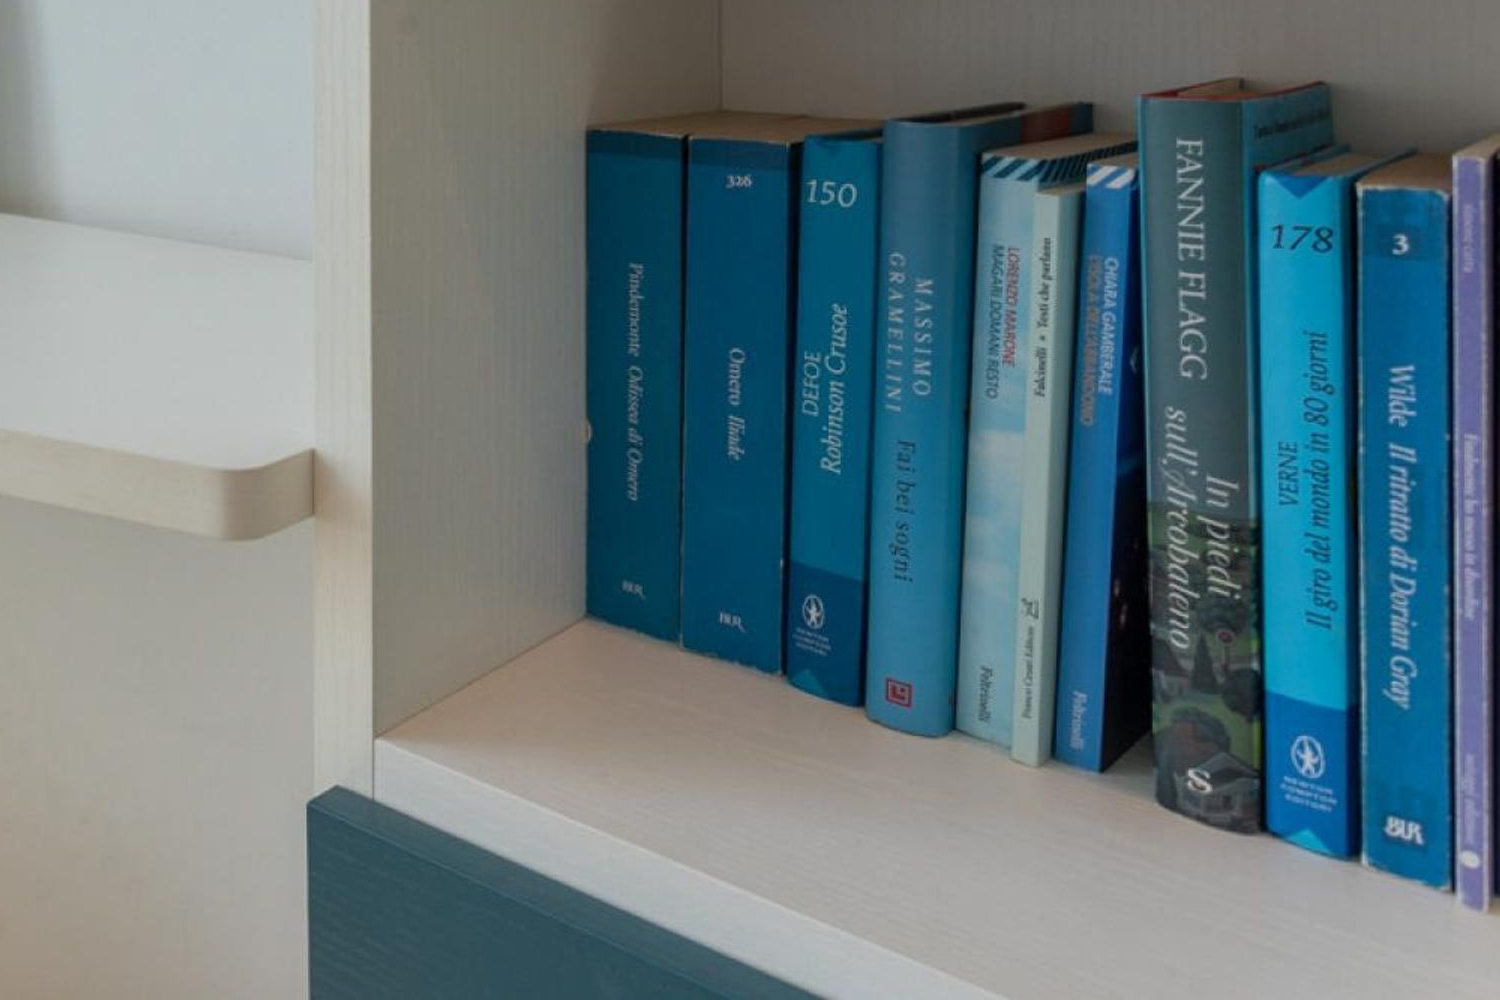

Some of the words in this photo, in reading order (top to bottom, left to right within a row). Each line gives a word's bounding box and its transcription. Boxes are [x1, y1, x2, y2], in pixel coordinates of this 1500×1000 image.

[725, 173, 753, 189] 326
[804, 178, 859, 209] 150
[1175, 136, 1205, 262] FANNIE
[1038, 237, 1052, 281] parlano
[1270, 223, 1335, 253] 178
[1392, 233, 1410, 256] 3
[990, 243, 1006, 298] MAGARI
[1005, 247, 1021, 307] LORENZO
[1038, 282, 1050, 302] che
[1103, 256, 1120, 309] CHIARA
[627, 262, 645, 357] Pindemonte
[885, 251, 907, 413] GRAMELLINI
[988, 299, 1003, 356] DOMANI
[1036, 303, 1050, 329] Testi
[1178, 269, 1208, 381] FLAGG
[824, 303, 848, 376] Crusoe
[912, 278, 934, 397] MASSIMO
[1001, 309, 1018, 369] MARONE
[1098, 310, 1117, 396] GAMBERALE
[1302, 329, 1336, 396] giorni
[627, 365, 645, 424] Odissea
[728, 347, 747, 406] Omero
[801, 350, 822, 417] DEFOE
[986, 358, 1001, 400] RESTO
[1388, 364, 1417, 427] Wilde
[626, 427, 644, 446] di
[727, 415, 746, 461] Iliade
[819, 380, 846, 475] Robinson
[1303, 397, 1330, 428] 80
[896, 439, 917, 474] Fai
[1306, 433, 1330, 454] in
[1389, 441, 1417, 463] Il
[626, 447, 643, 501] Omero
[895, 479, 916, 516] bei
[1204, 474, 1240, 509] In
[1277, 441, 1299, 507] VERNE
[1304, 460, 1331, 530] mondo
[1389, 464, 1417, 542] ritratto
[888, 521, 914, 584] sogni
[1196, 513, 1242, 600] piedi
[1303, 532, 1332, 565] del
[1389, 546, 1417, 572] di
[1306, 568, 1339, 610] giro
[1390, 572, 1418, 651] Dorian
[1304, 611, 1333, 631] Il
[977, 665, 994, 723] Feltrinelli
[1383, 654, 1418, 709] Gray
[1069, 690, 1088, 751] Feltrinelli
[1382, 814, 1426, 847] BUR
